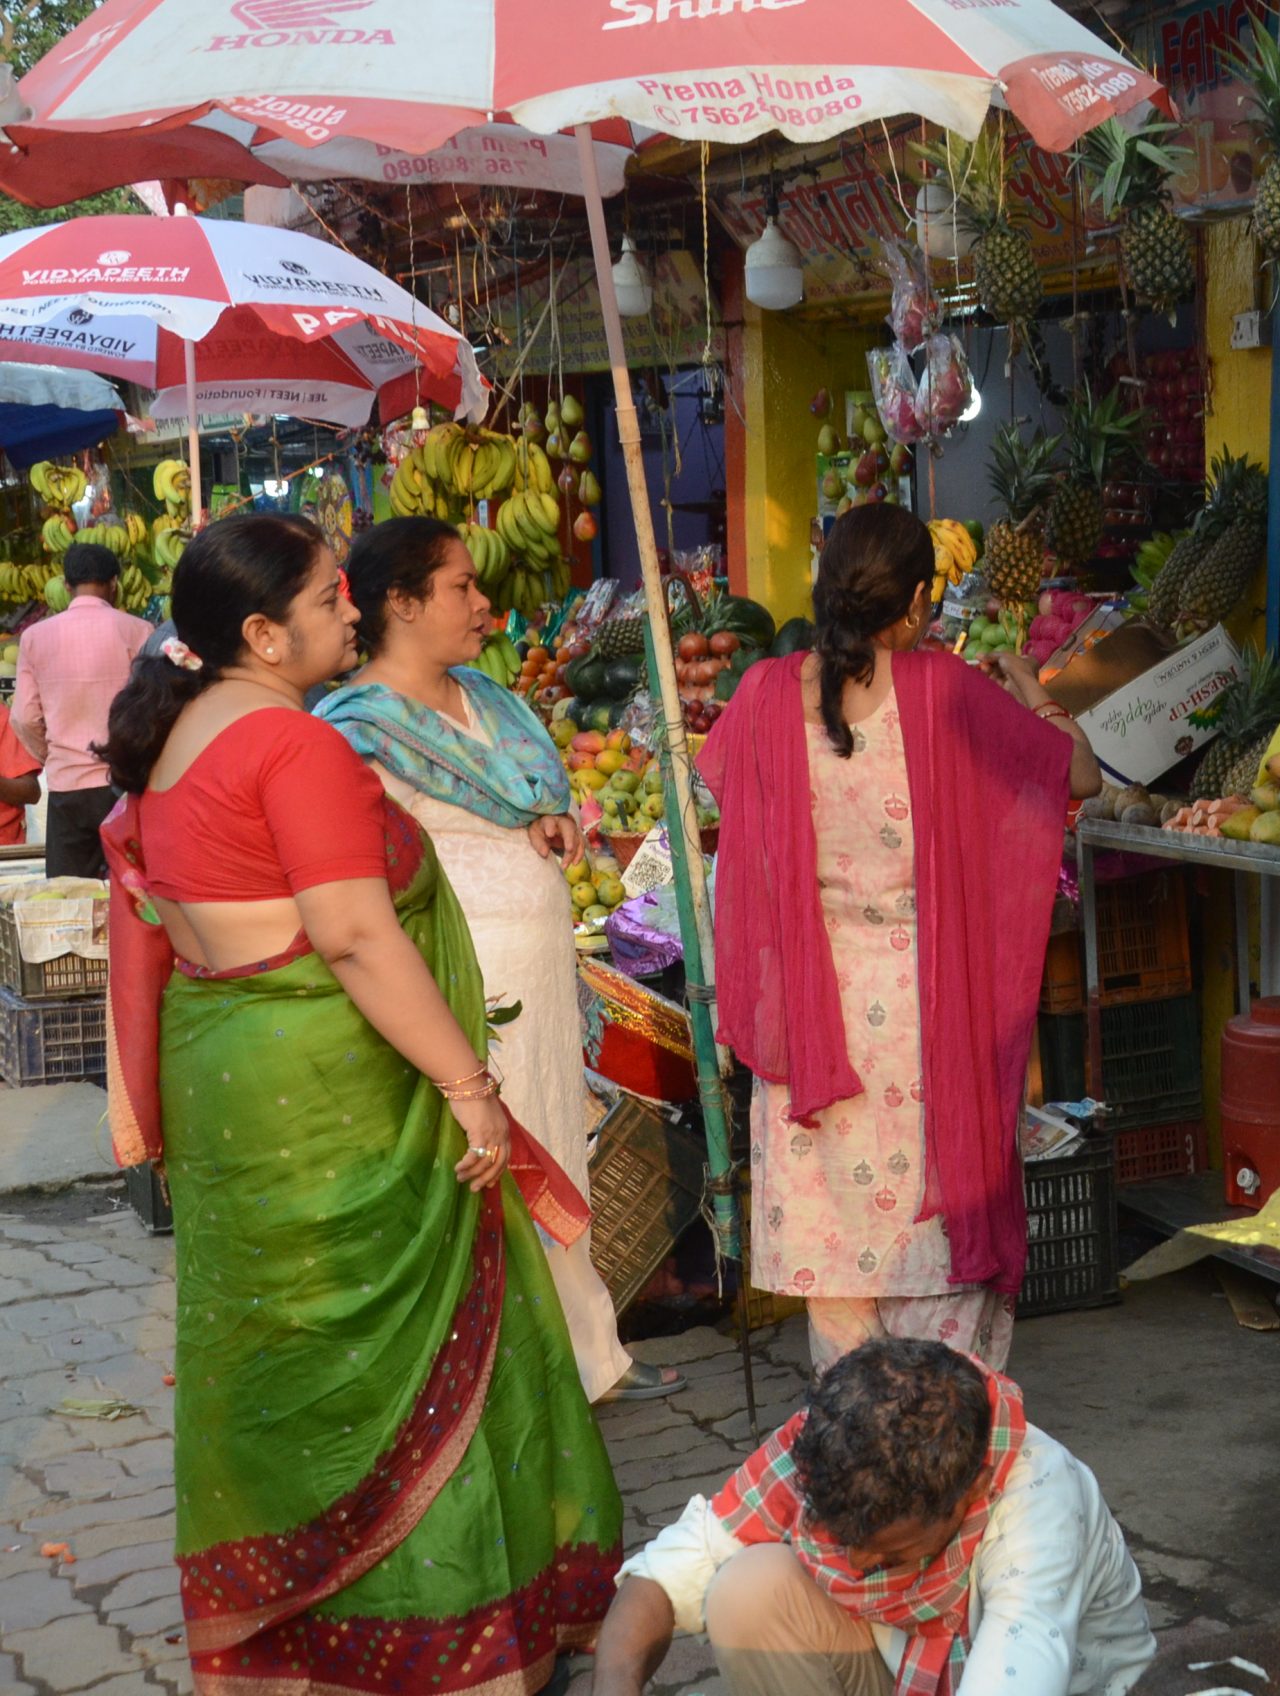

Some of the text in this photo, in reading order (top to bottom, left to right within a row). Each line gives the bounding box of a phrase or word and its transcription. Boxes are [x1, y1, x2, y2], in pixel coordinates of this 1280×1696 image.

[204, 28, 396, 52] HONDA
[637, 71, 855, 102] Prema Honda
[22, 266, 190, 281] VIDYAPEETH
[243, 272, 384, 301] VIDYAPEETH
[87, 296, 172, 315] oundation
[1113, 696, 1153, 738] apple
